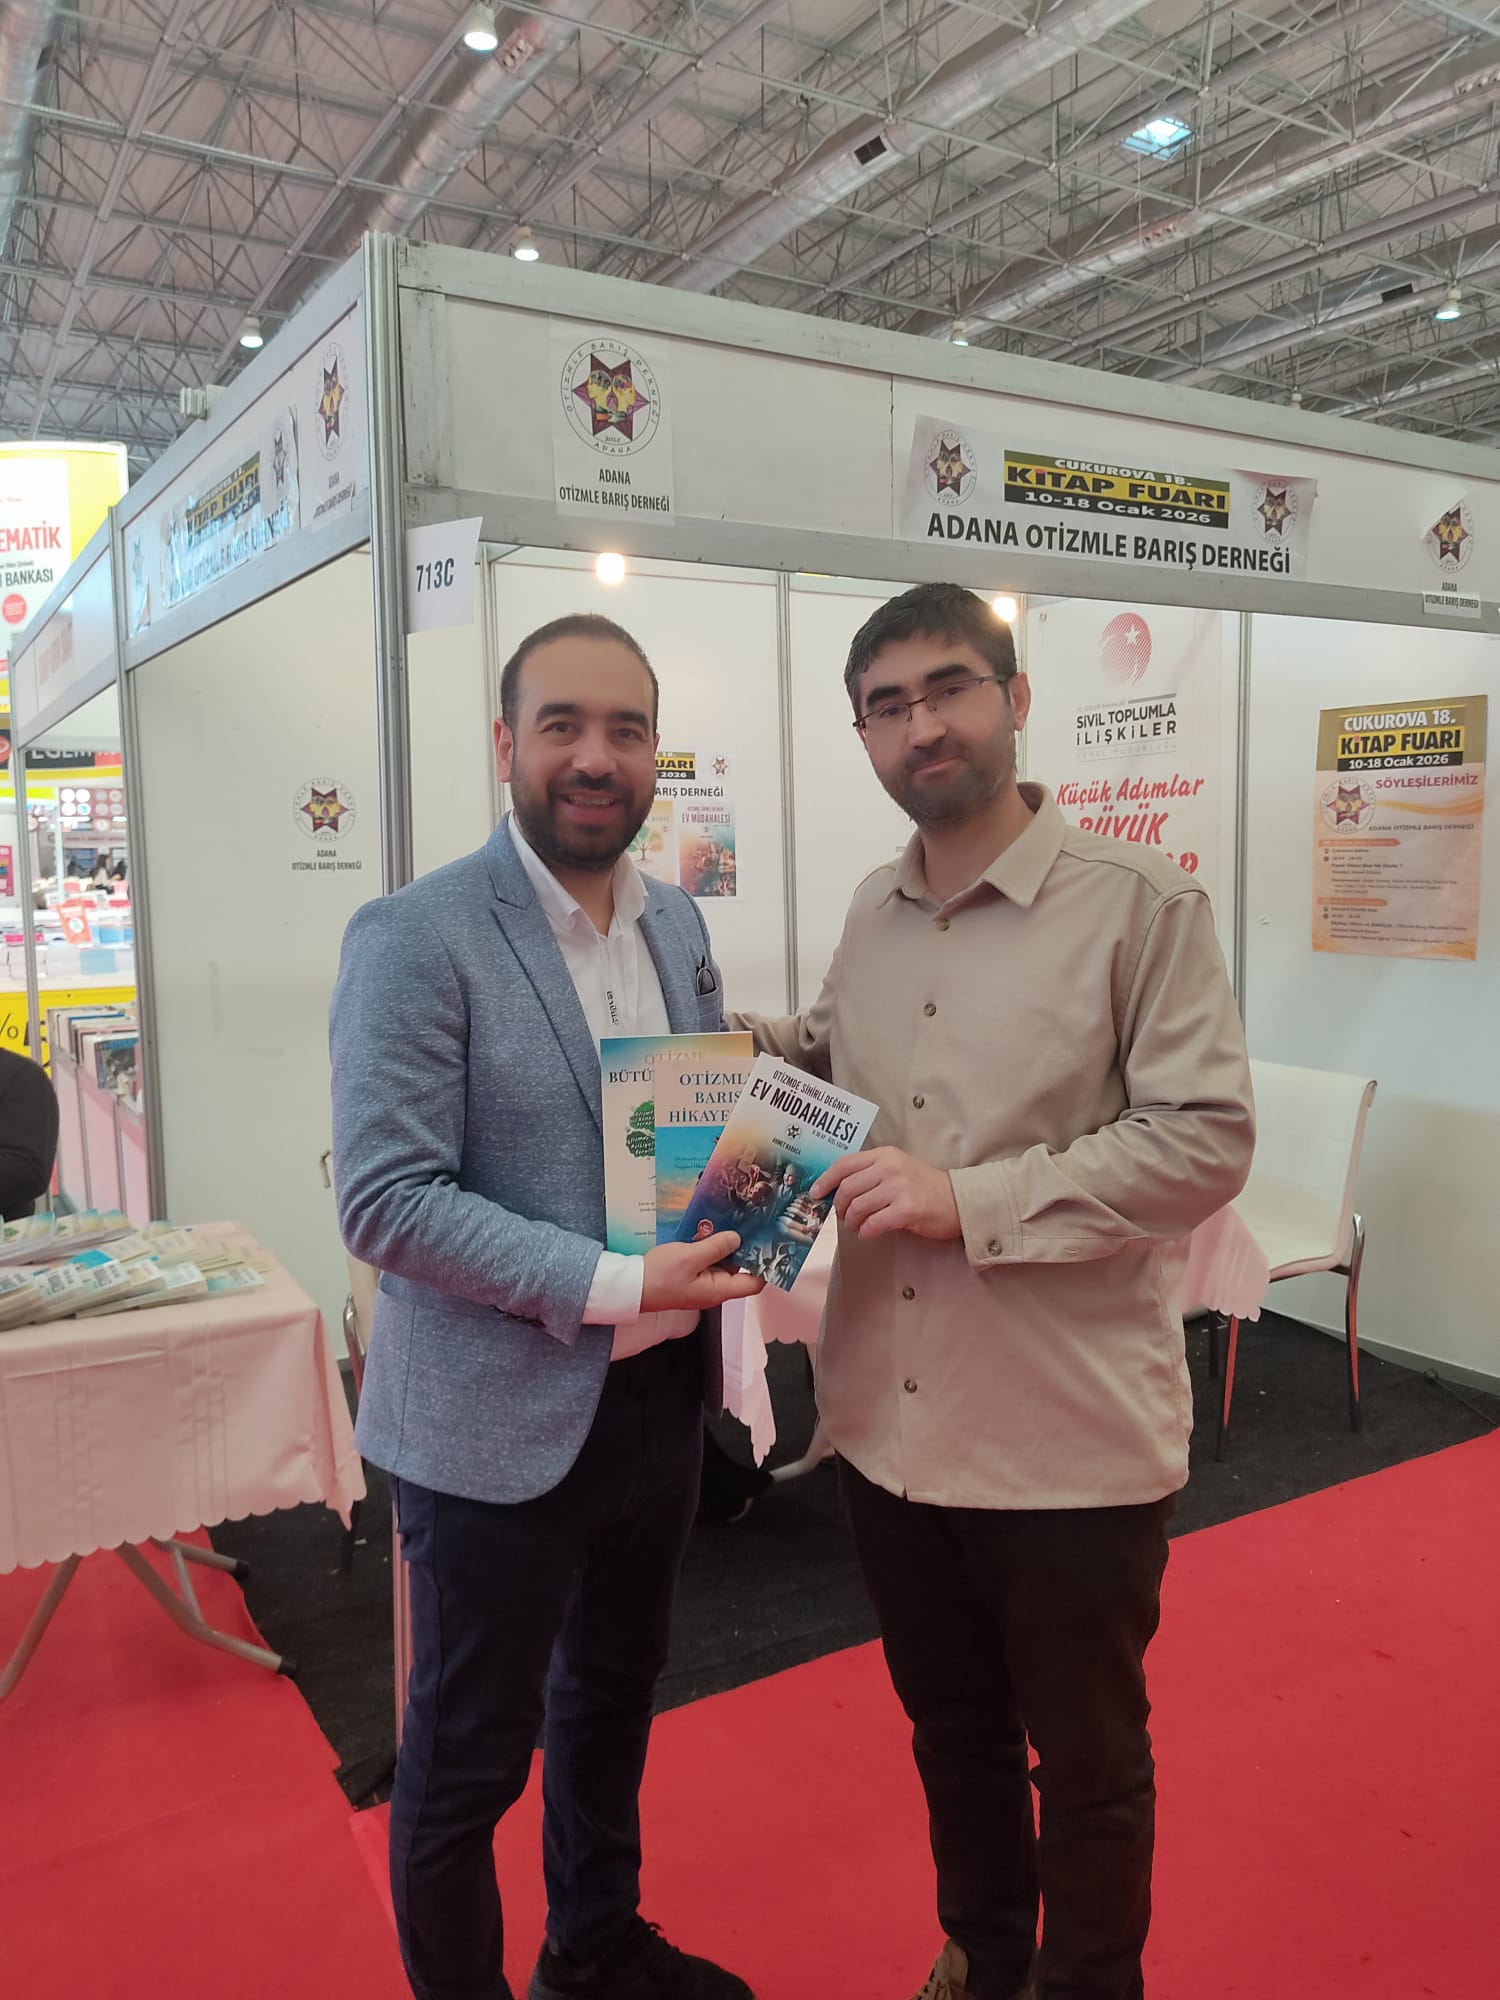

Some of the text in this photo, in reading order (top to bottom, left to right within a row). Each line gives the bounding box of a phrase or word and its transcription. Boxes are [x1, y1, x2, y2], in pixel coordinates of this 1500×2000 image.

[598, 468, 632, 486] ADANA
[1164, 474, 1193, 486] 18.
[1007, 465, 1226, 510] KİTAP FUARI
[558, 484, 670, 513] OTİZMLE BARIŞ DERNEĞİ
[1024, 491, 1211, 523] 10-18 Ocak 2026
[927, 512, 1290, 574] ADANA OTİZMLE BARIŞ DERNEĞİ
[6, 568, 53, 588] BANKASI
[416, 557, 455, 593] 713C
[1441, 581, 1458, 592] ADANA
[1076, 712, 1106, 729] SİVİL
[1108, 702, 1176, 725] TOPLUMLA
[1432, 709, 1456, 726] 18.
[1340, 729, 1461, 755] KİTAP FUARI
[656, 759, 694, 769] UARI
[1348, 754, 1449, 770] 10-18 Ocak 2026
[1375, 772, 1479, 789] SÖYLEŞİLERİMİZ
[655, 785, 724, 799] ARIŞ DERNEĞİ
[1056, 773, 1205, 811] Küçük Adımlar
[609, 1067, 655, 1083] BÜTÜ
[679, 1070, 751, 1086] OTİZML
[772, 1070, 853, 1115] OTİZMDE SİHİRLİ DEĞNEK:
[669, 1107, 733, 1123] HİKAYE
[750, 1078, 860, 1144] EV MÜDAHALESİ
